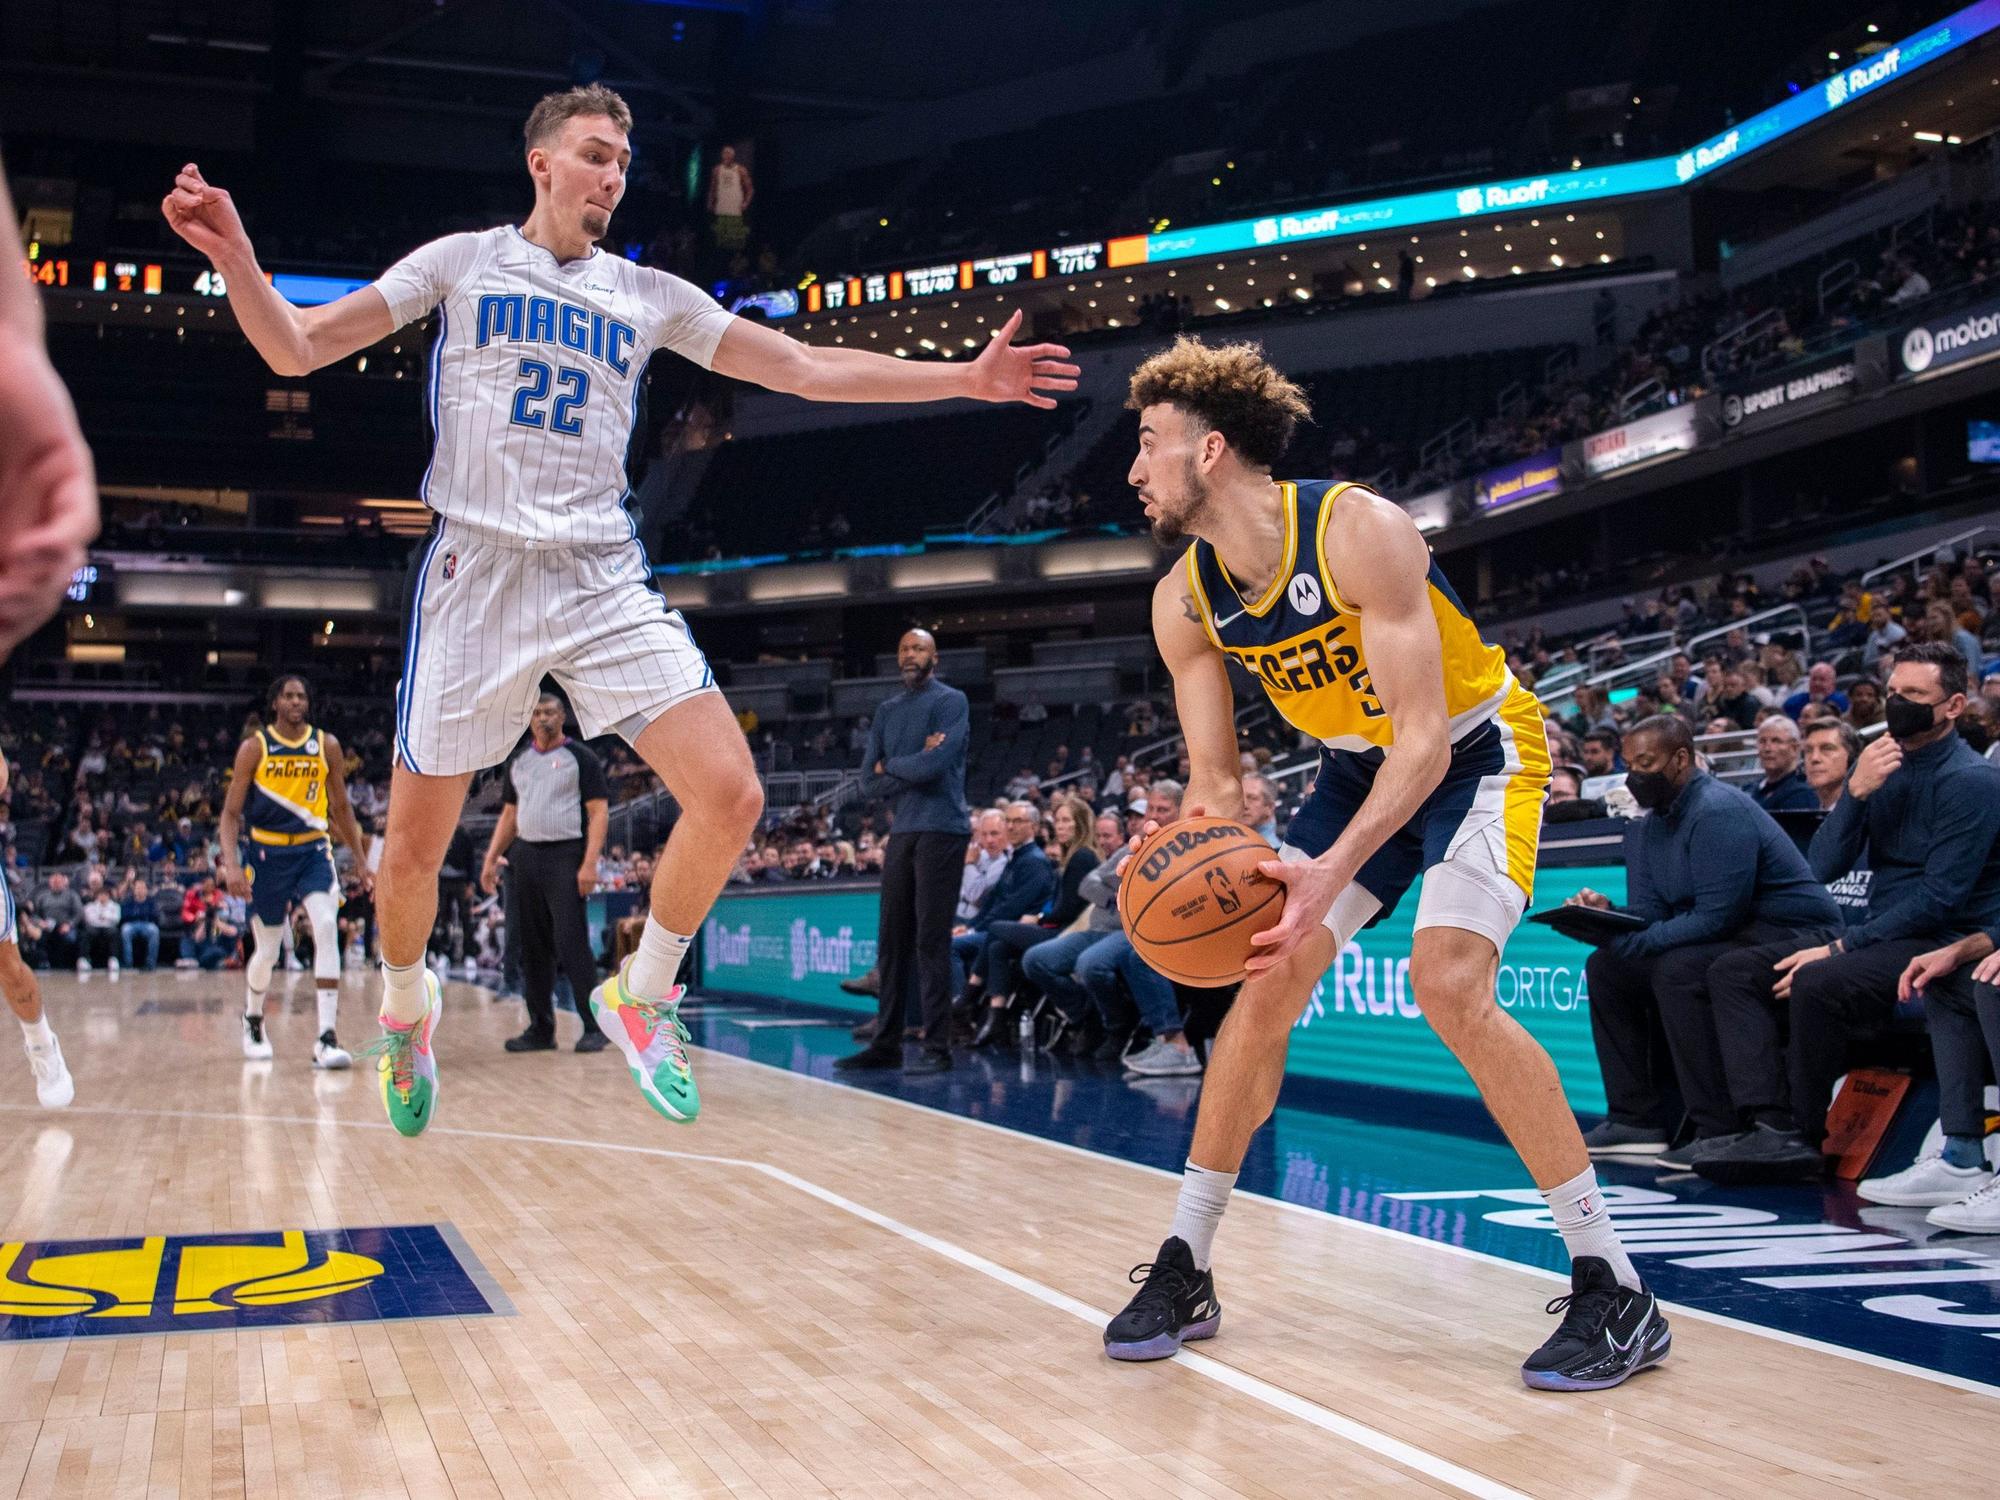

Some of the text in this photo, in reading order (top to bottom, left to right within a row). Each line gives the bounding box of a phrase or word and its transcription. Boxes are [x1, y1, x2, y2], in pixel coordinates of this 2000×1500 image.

[1850, 48, 1900, 93] Ruoff
[1697, 130, 1739, 169] Ruoff
[1486, 178, 1549, 207] Ruoff
[1280, 209, 1340, 238] Ruoff
[987, 266, 1018, 285] 0/0
[1058, 254, 1097, 275] 7/16
[118, 275, 132, 291] 2
[192, 270, 228, 297] 43
[866, 286, 887, 303] 15
[825, 292, 846, 309] 17
[476, 293, 637, 380] MAGIC
[510, 357, 591, 438] 22
[1743, 363, 1854, 416] SPORT GRAPHICS
[265, 759, 320, 778] PACERS
[306, 780, 321, 804] 8
[1137, 825, 1248, 882] Wilson
[808, 926, 853, 976] Ruoff
[1334, 939, 1591, 1020] Ruo ORTGA
